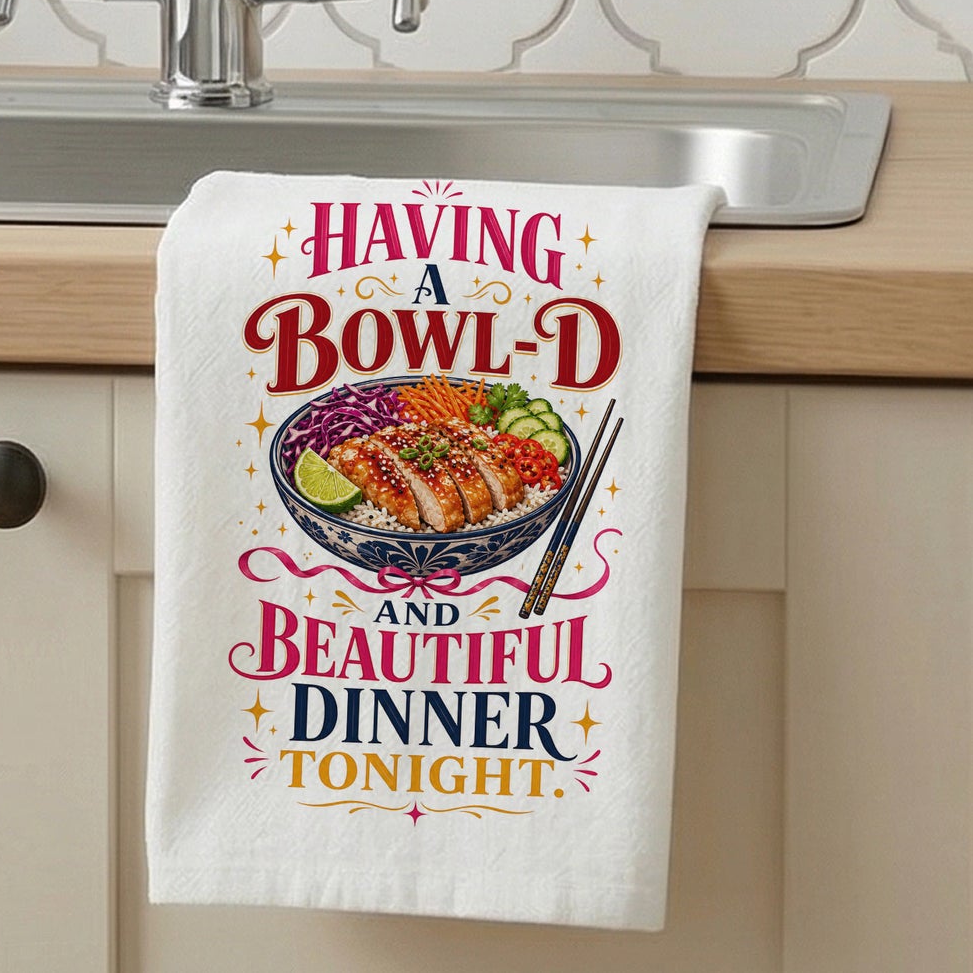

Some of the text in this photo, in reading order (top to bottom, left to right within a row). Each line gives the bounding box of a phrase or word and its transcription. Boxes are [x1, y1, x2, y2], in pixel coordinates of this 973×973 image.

[301, 202, 565, 290] HAVING
[411, 263, 451, 306] A
[243, 292, 623, 396] BOWL-D
[228, 599, 612, 689] BEAUTIFUL
[373, 599, 460, 627] AND
[289, 682, 578, 762] DINNER
[279, 749, 565, 799] TONIGHT.
